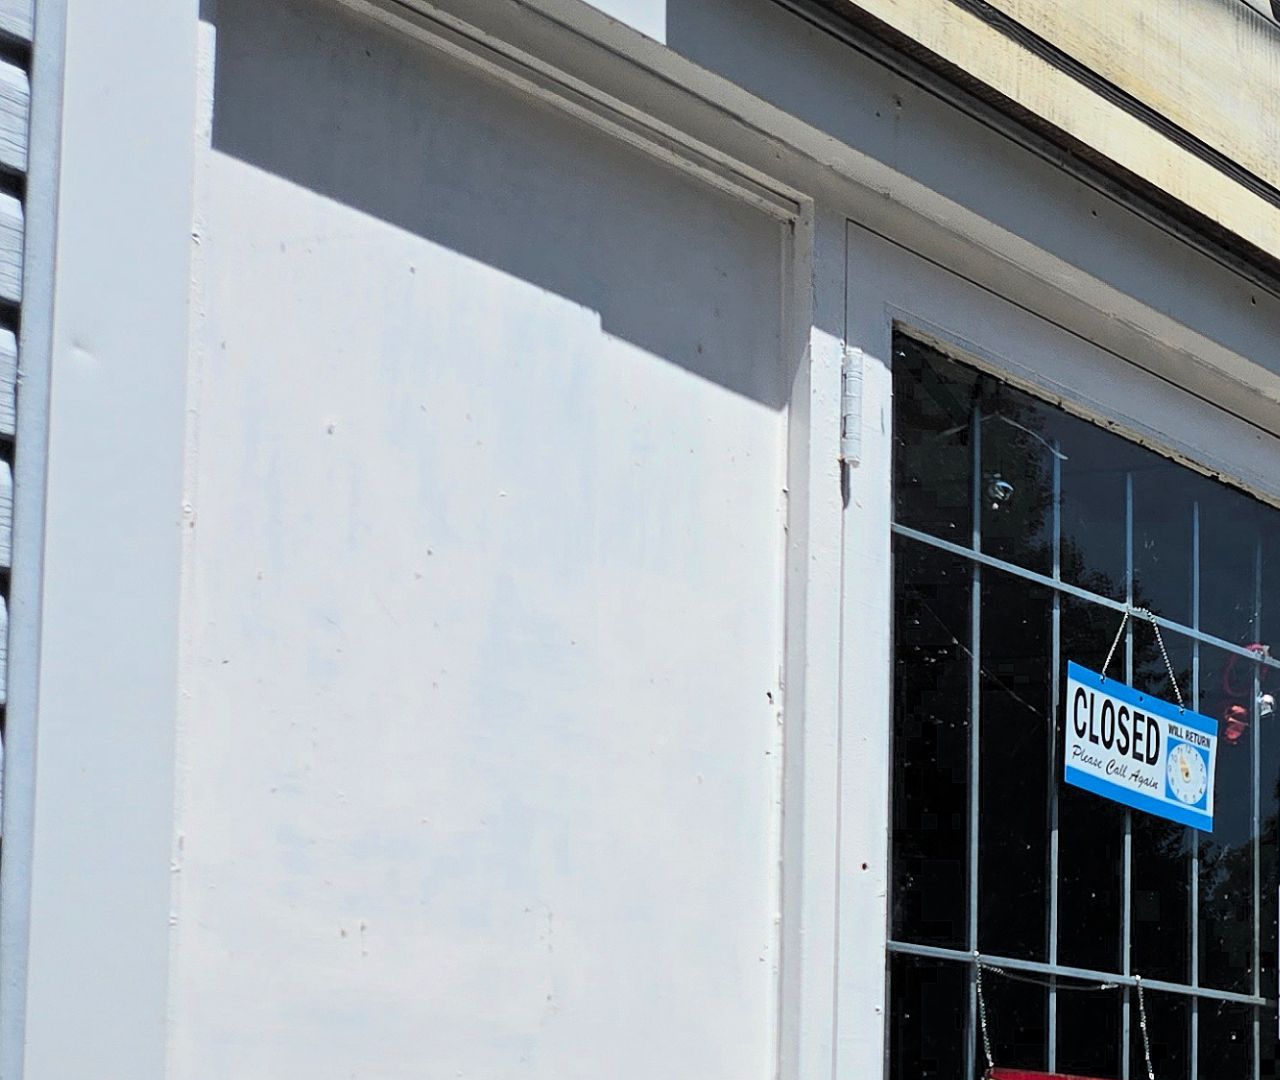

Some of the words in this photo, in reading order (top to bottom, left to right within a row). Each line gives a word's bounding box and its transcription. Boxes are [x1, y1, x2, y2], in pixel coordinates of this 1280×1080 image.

[1074, 687, 1160, 766] CLOSED
[1168, 724, 1183, 739] WILL
[1185, 730, 1210, 749] RETURN
[1072, 744, 1102, 769] Please
[1105, 759, 1126, 778] Call
[1129, 770, 1158, 789] Again
